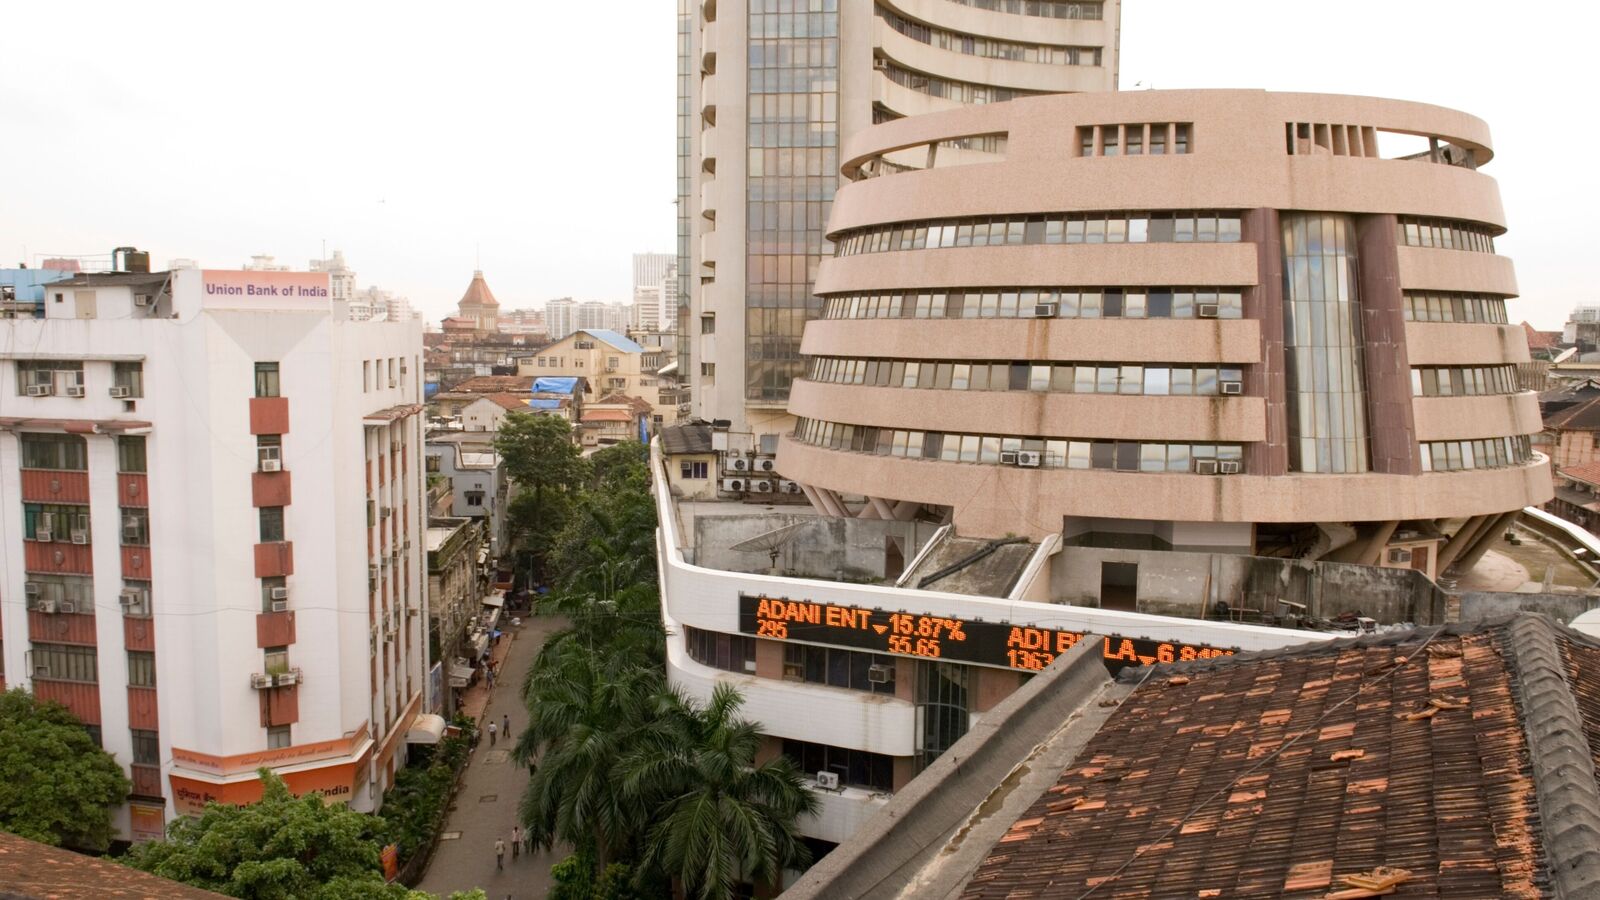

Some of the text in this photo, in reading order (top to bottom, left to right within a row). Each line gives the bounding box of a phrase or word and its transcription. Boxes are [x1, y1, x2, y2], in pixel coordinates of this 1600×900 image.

[206, 283, 327, 297] Union Bank of India
[757, 599, 966, 642] ADANI ENT 15.87%
[757, 619, 788, 639] 295
[888, 634, 941, 658] 55.65
[1008, 627, 1050, 651] ADI
[1057, 632, 1137, 661] BLA
